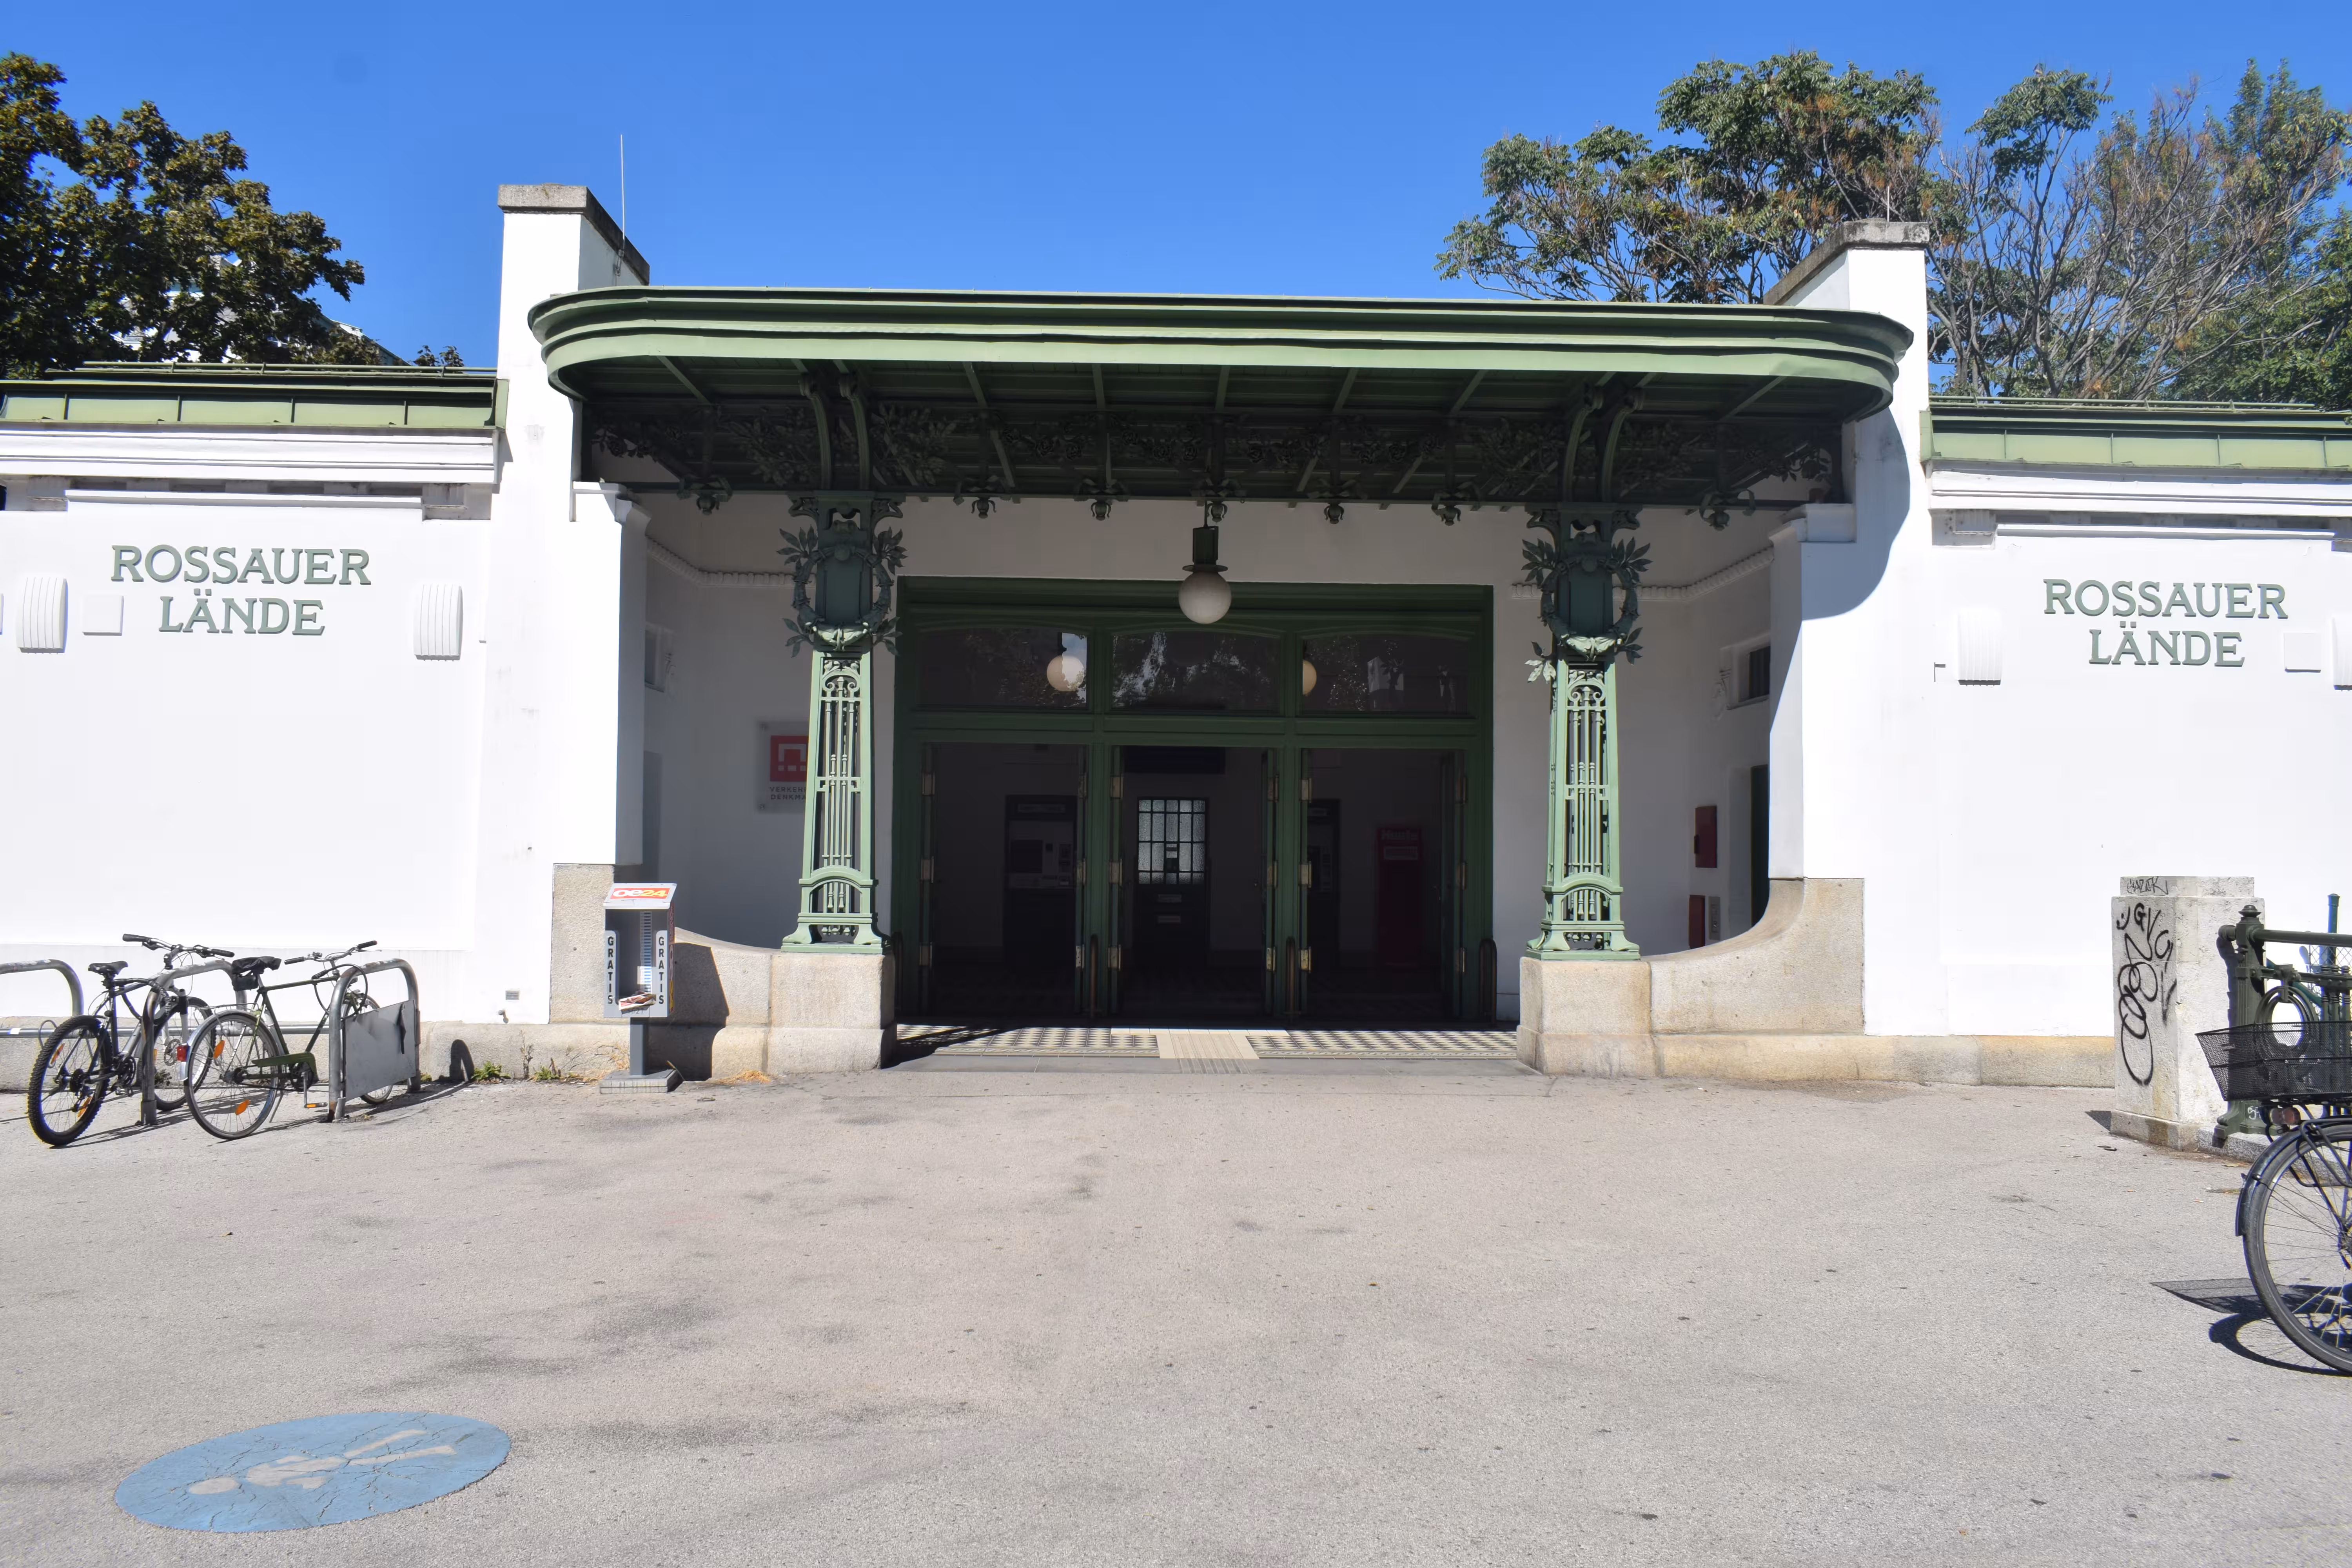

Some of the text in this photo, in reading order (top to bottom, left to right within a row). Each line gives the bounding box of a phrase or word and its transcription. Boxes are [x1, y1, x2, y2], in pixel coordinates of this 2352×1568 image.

[111, 545, 371, 585] ROSSAUER
[159, 589, 325, 635] LÄNDE
[2043, 580, 2288, 619] ROSSAUER
[2089, 621, 2245, 667] LÄNDE
